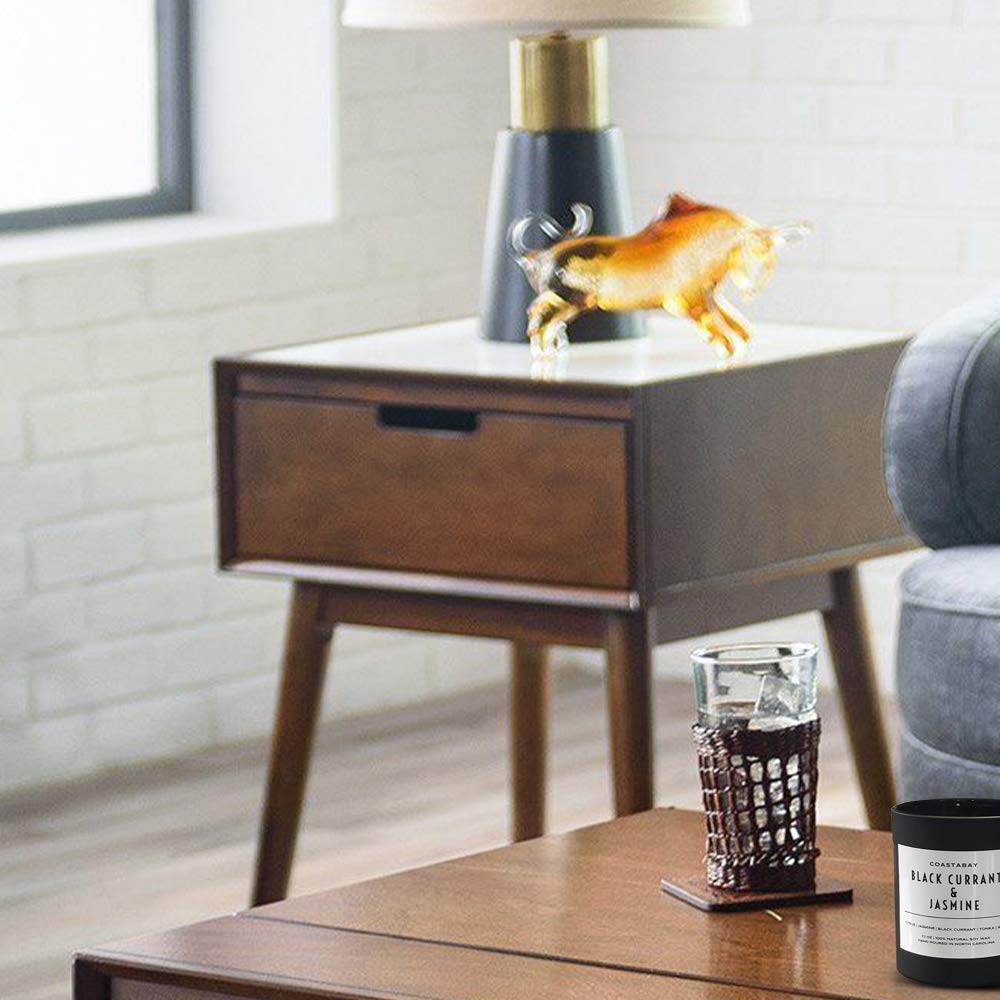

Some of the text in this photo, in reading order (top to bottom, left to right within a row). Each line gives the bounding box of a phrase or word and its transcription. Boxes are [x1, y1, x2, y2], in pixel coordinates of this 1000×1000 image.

[911, 869, 942, 884] BLACK
[950, 887, 958, 898] &
[929, 898, 980, 911] JASMINE
